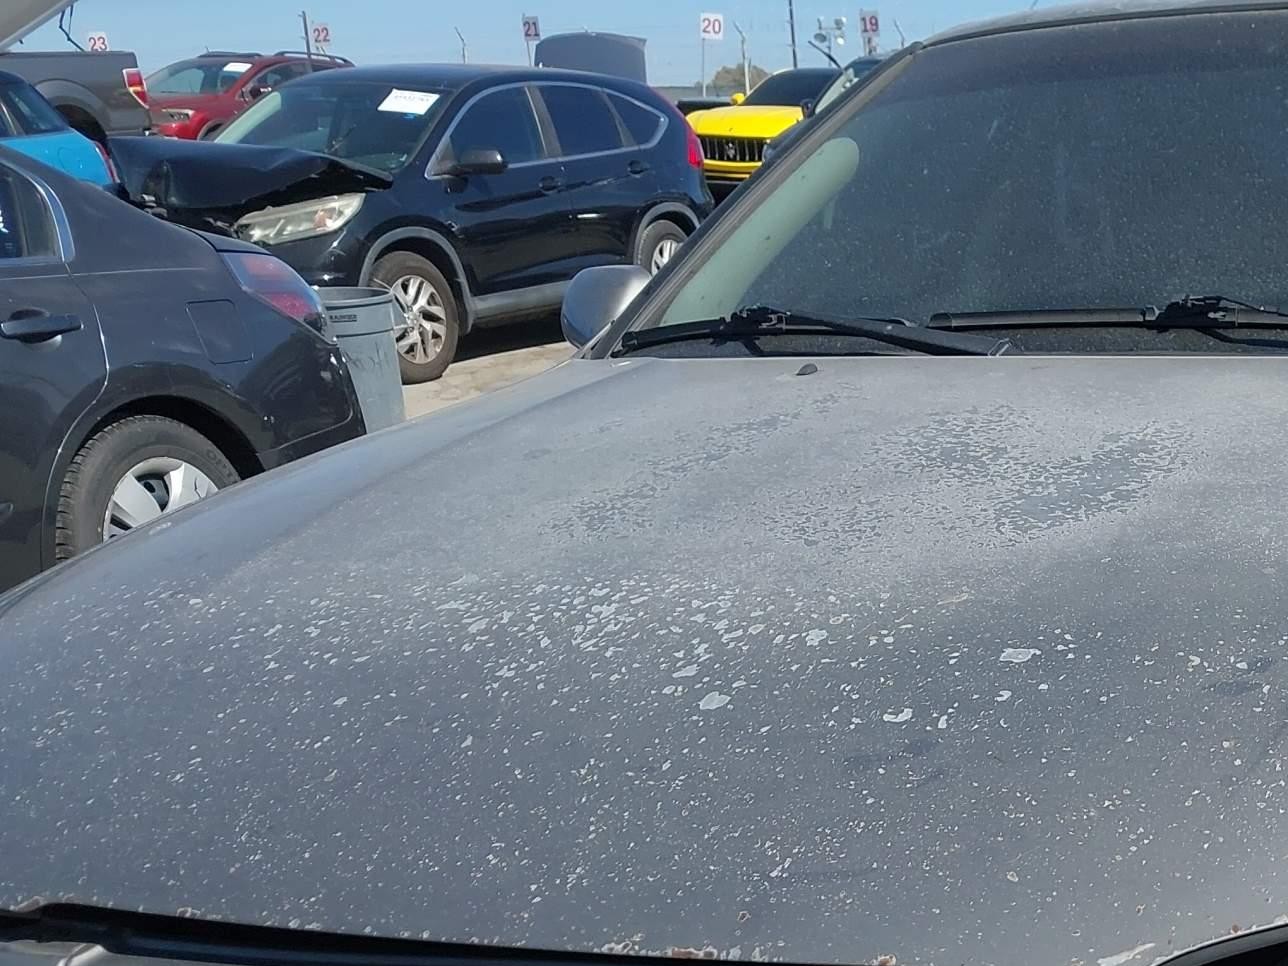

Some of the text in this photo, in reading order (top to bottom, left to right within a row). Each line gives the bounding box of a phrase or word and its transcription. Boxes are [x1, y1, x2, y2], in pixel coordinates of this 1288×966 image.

[523, 20, 540, 37] 21
[702, 17, 722, 34] 20
[861, 15, 879, 33] 19
[88, 36, 108, 51] 23
[313, 27, 331, 43] 22
